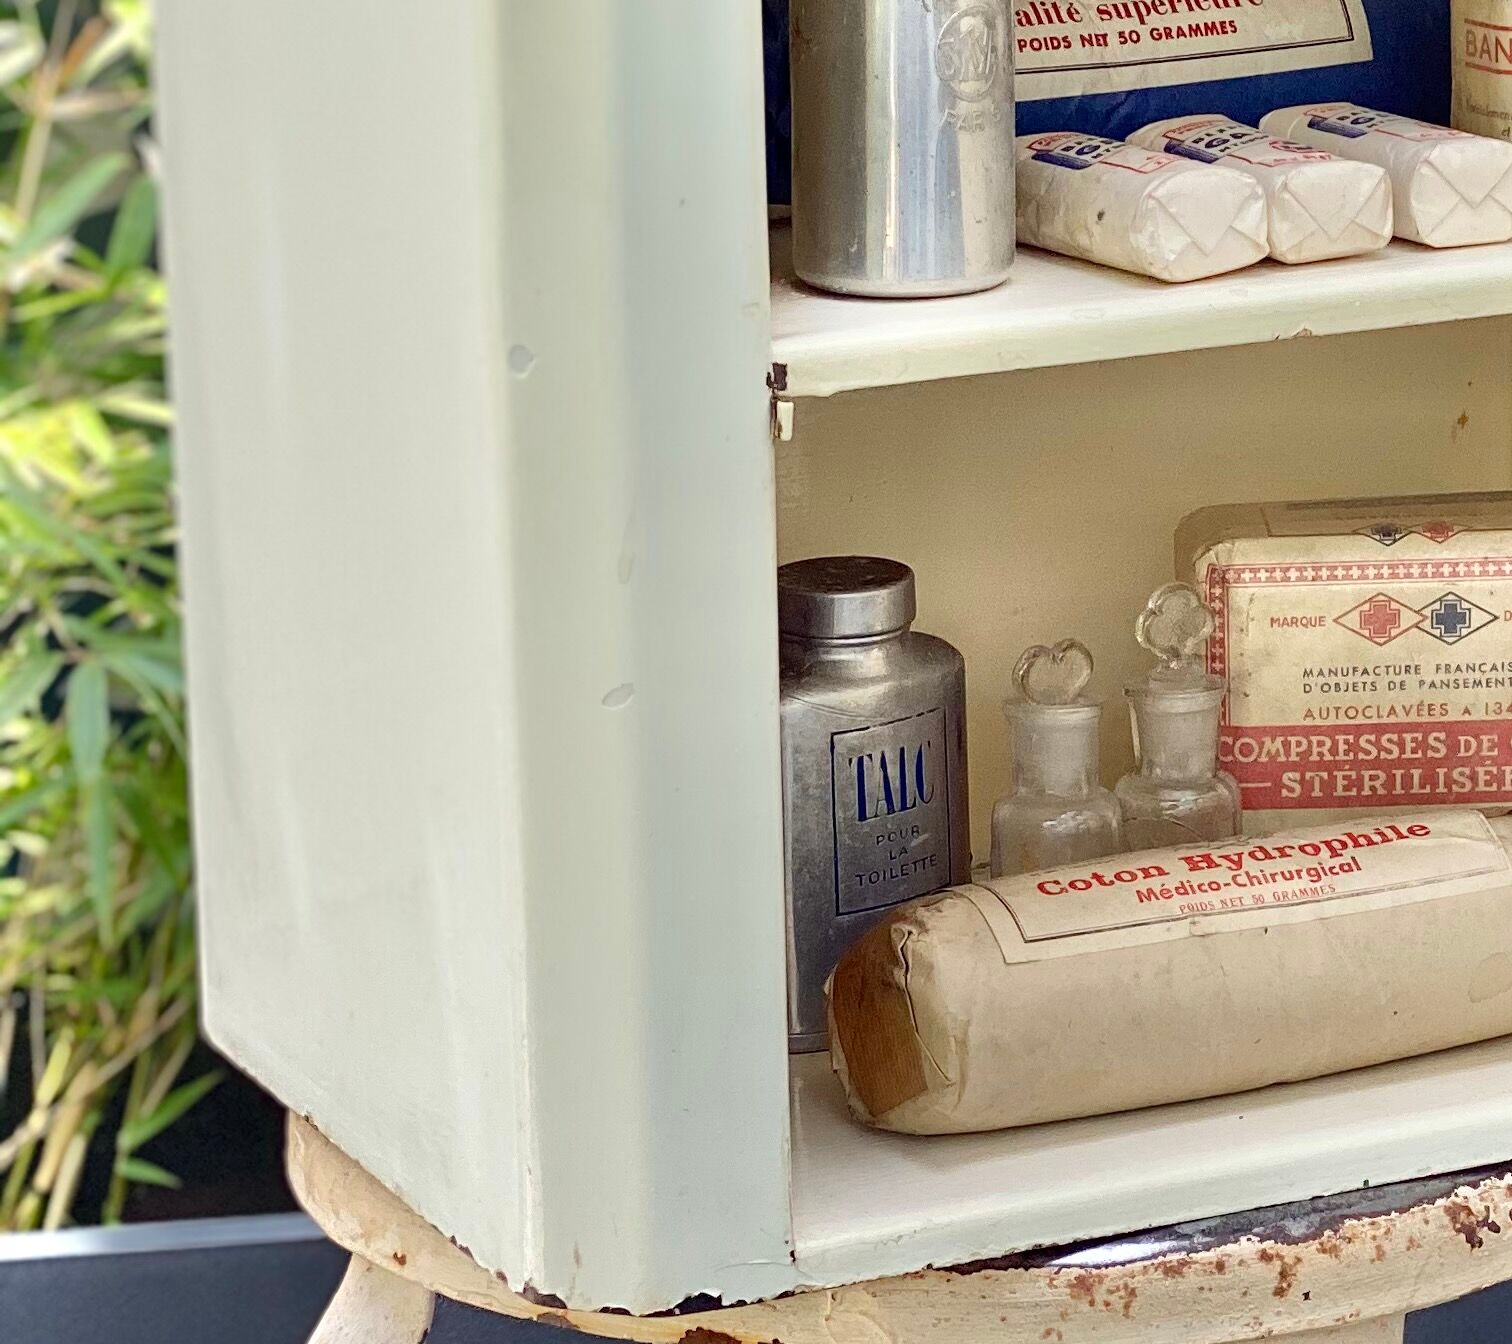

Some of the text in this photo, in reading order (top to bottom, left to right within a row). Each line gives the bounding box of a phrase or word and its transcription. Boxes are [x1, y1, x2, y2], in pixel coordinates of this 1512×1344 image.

[1015, 0, 1083, 28] alité
[1016, 20, 1238, 53] POIDS NET 50 GRAMMES
[1270, 615, 1327, 629] MARQUE
[1302, 664, 1422, 679] MANUFACTURE
[1303, 681, 1378, 695] D'OBJETS
[1387, 680, 1407, 692] DE
[1303, 700, 1449, 722] AUTOCLAVÉES
[1461, 708, 1472, 717] A
[1218, 731, 1448, 764] COMPRESSES
[1457, 735, 1498, 757] DE
[849, 740, 935, 823] TALC
[876, 824, 920, 846] POUR
[889, 848, 909, 861] LA
[1036, 823, 1432, 896] Coton Hydrophile
[855, 854, 938, 887] TOILETTE
[1135, 855, 1363, 903] Médico-Chirurgical
[1179, 884, 1337, 915] POIDS NET 50 GRAMMES
